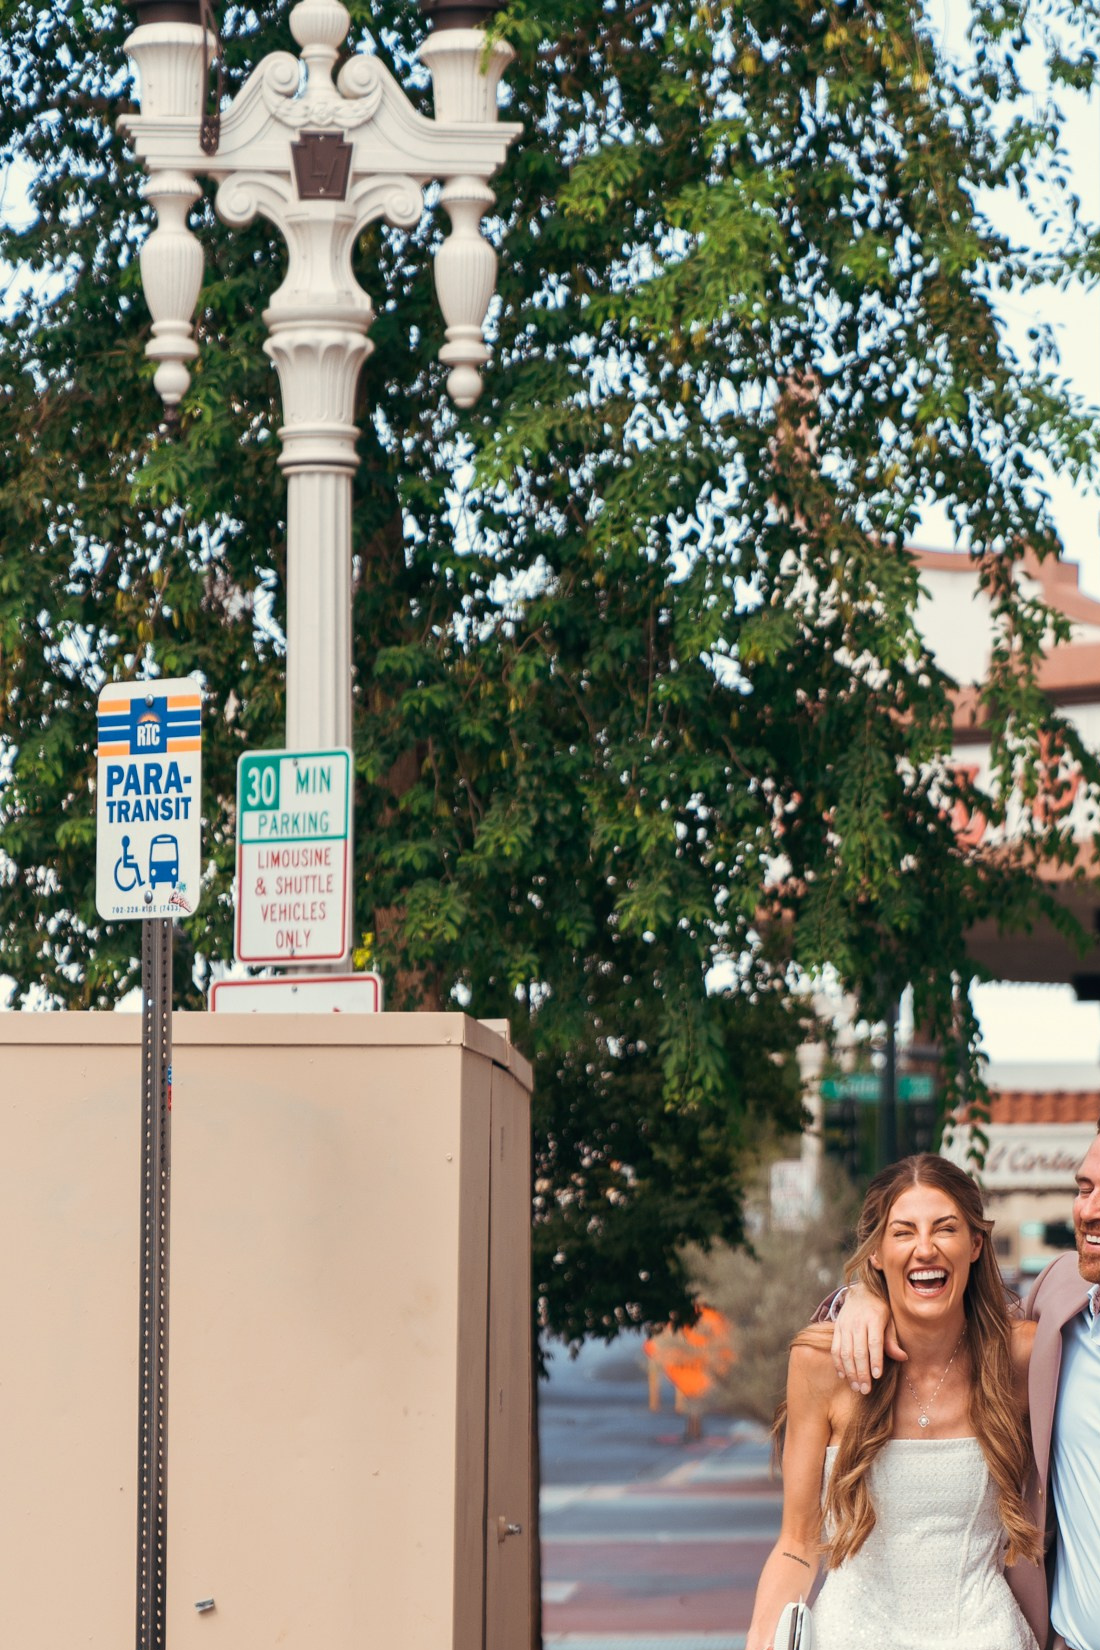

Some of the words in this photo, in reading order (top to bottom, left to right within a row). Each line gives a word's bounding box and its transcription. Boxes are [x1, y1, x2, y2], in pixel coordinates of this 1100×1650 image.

[136, 723, 161, 747] RTC
[106, 761, 192, 798] PARA-
[246, 765, 277, 807] 30
[295, 765, 332, 795] MIN
[106, 796, 192, 824] TRANSIT
[258, 811, 330, 836] PARKING
[257, 847, 332, 869] LIMOUSINE
[254, 876, 267, 896] &
[275, 874, 333, 896] SHUTTLE
[260, 901, 327, 923] VEHICLES
[275, 929, 312, 949] ONLY
